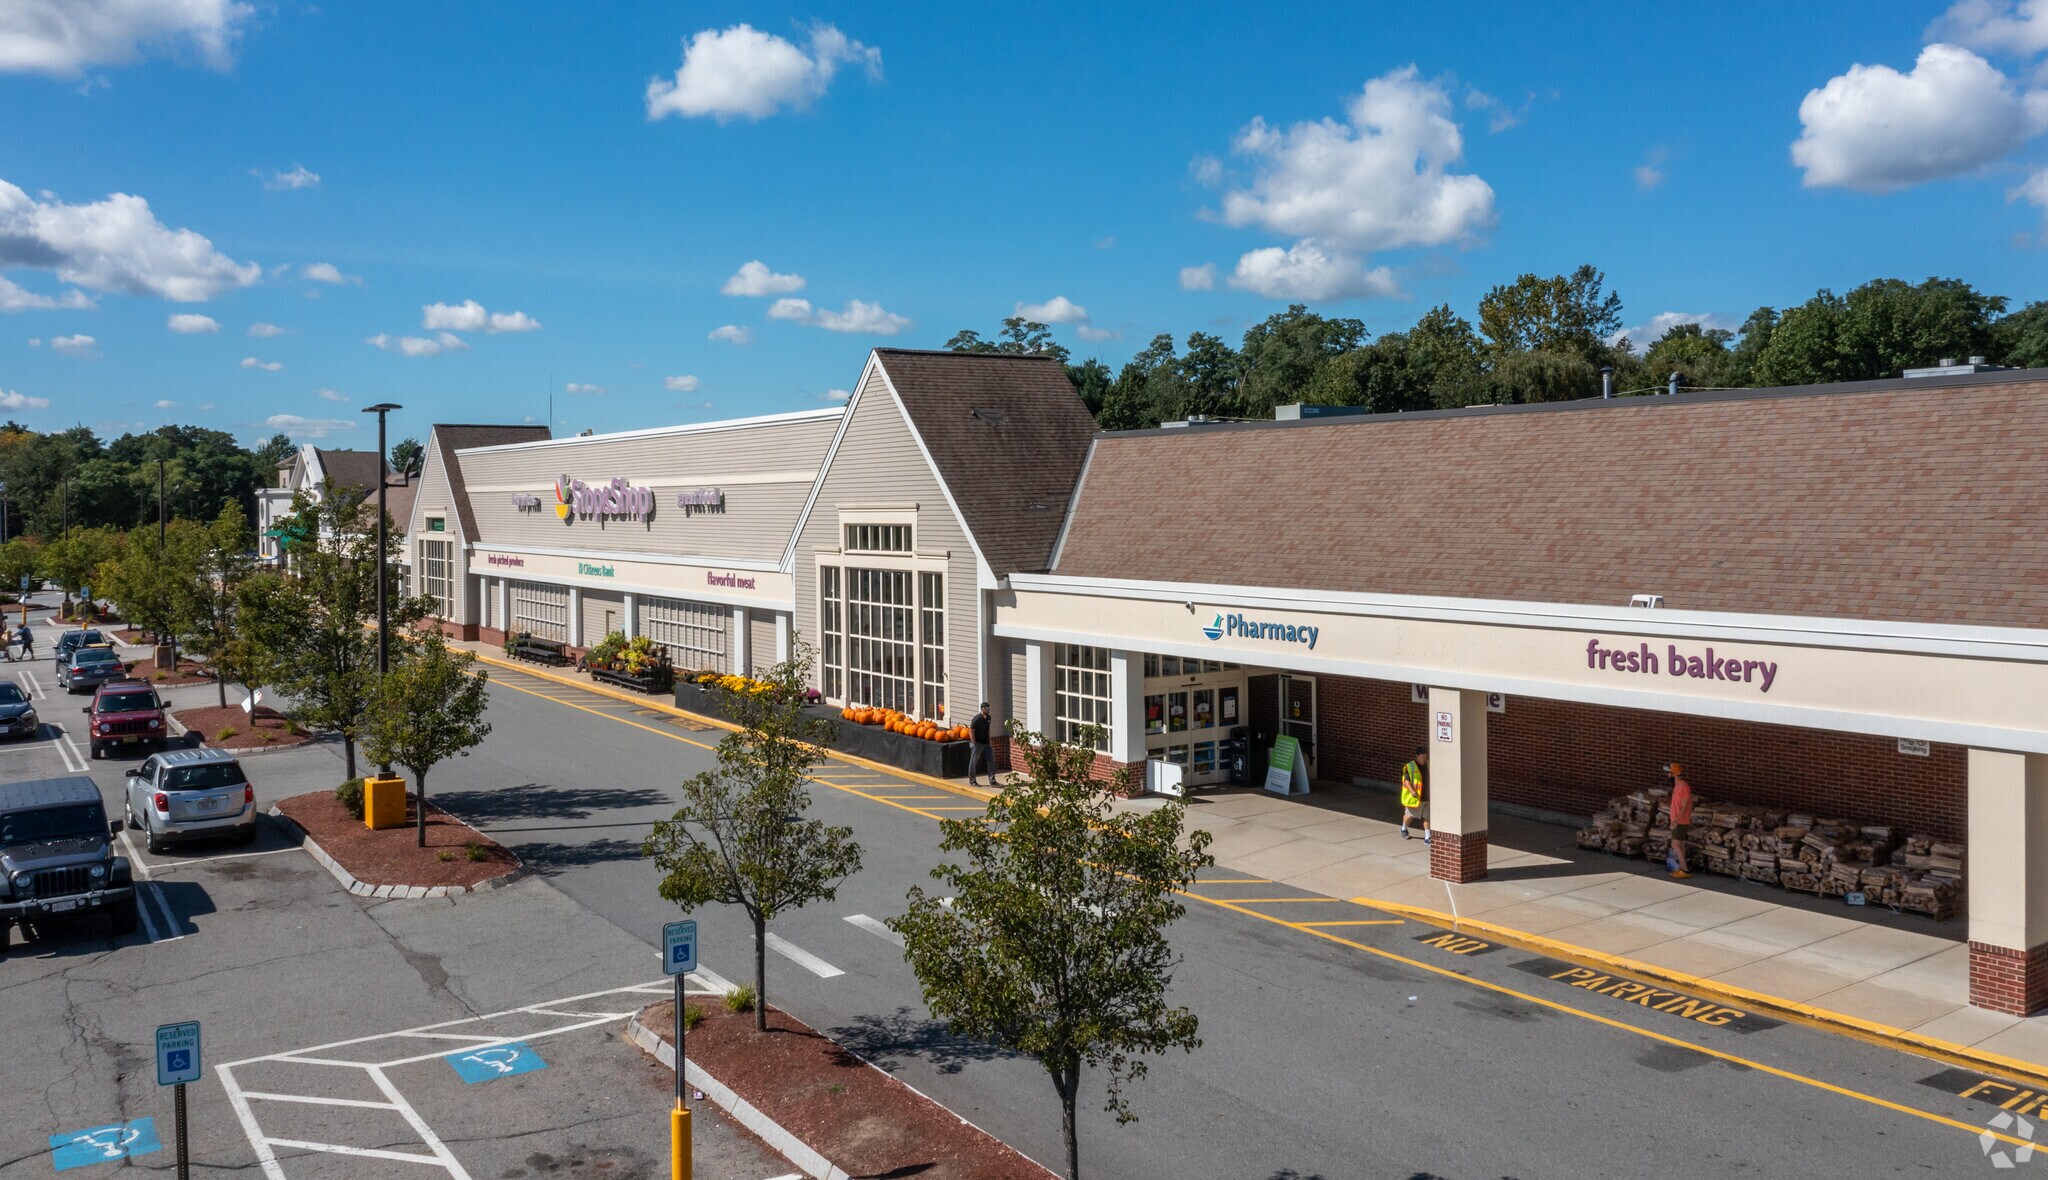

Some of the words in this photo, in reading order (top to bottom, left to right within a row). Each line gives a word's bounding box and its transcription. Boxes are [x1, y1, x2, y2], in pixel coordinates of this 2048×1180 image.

[707, 571, 735, 588] flavorful
[737, 577, 755, 590] meat
[1226, 613, 1319, 650] Pharmacy
[1586, 639, 1659, 675] fresh
[1668, 644, 1778, 693] bakery
[1900, 743, 1927, 754] Smoking
[668, 926, 694, 935] RESERVED
[670, 934, 692, 944] PARKING
[1422, 933, 1489, 955] NO
[1548, 967, 1747, 1027] PARKING
[160, 1029, 195, 1040] RESERVED
[162, 1039, 194, 1050] PARKING
